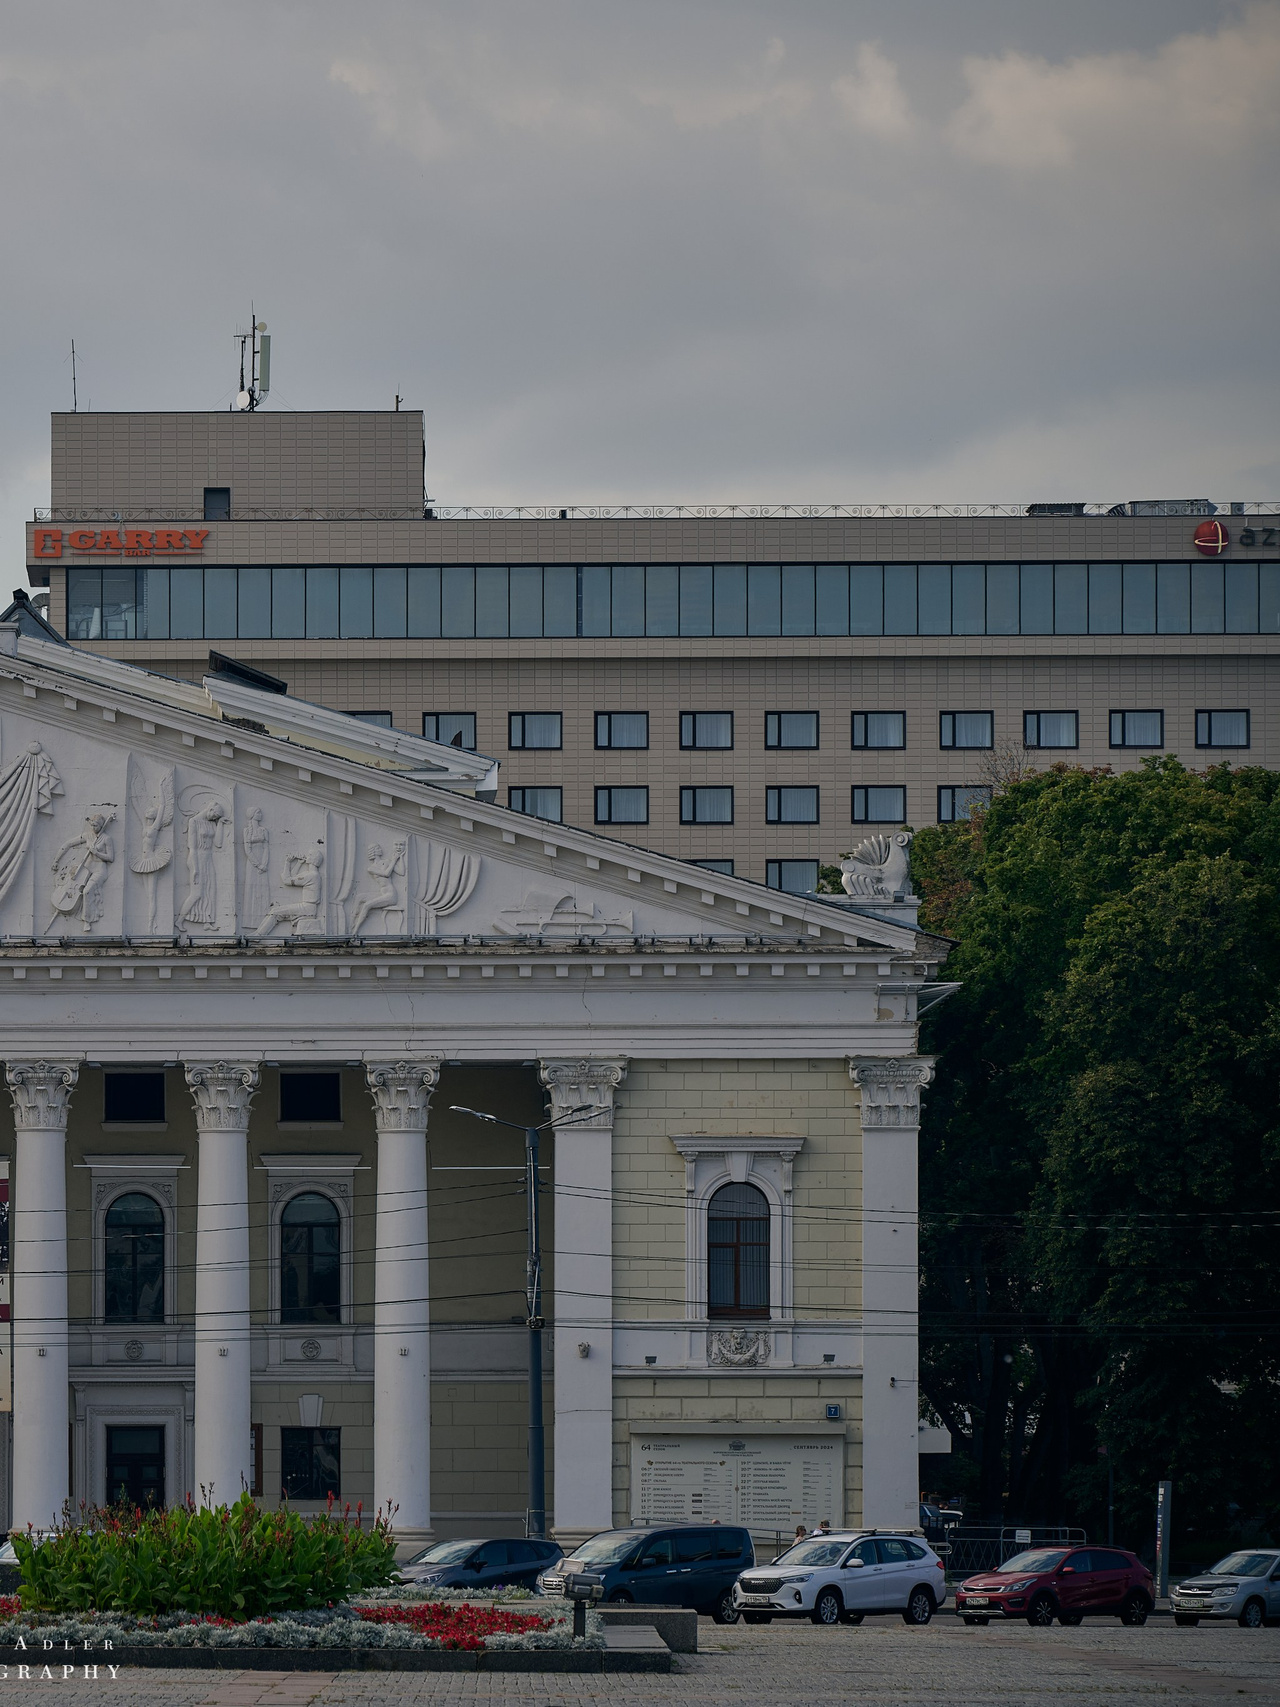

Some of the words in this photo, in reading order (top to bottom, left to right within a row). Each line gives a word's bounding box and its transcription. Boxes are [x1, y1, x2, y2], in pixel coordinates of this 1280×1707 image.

[68, 529, 209, 549] GARRY
[1240, 528, 1276, 547] az
[124, 549, 151, 557] BAR
